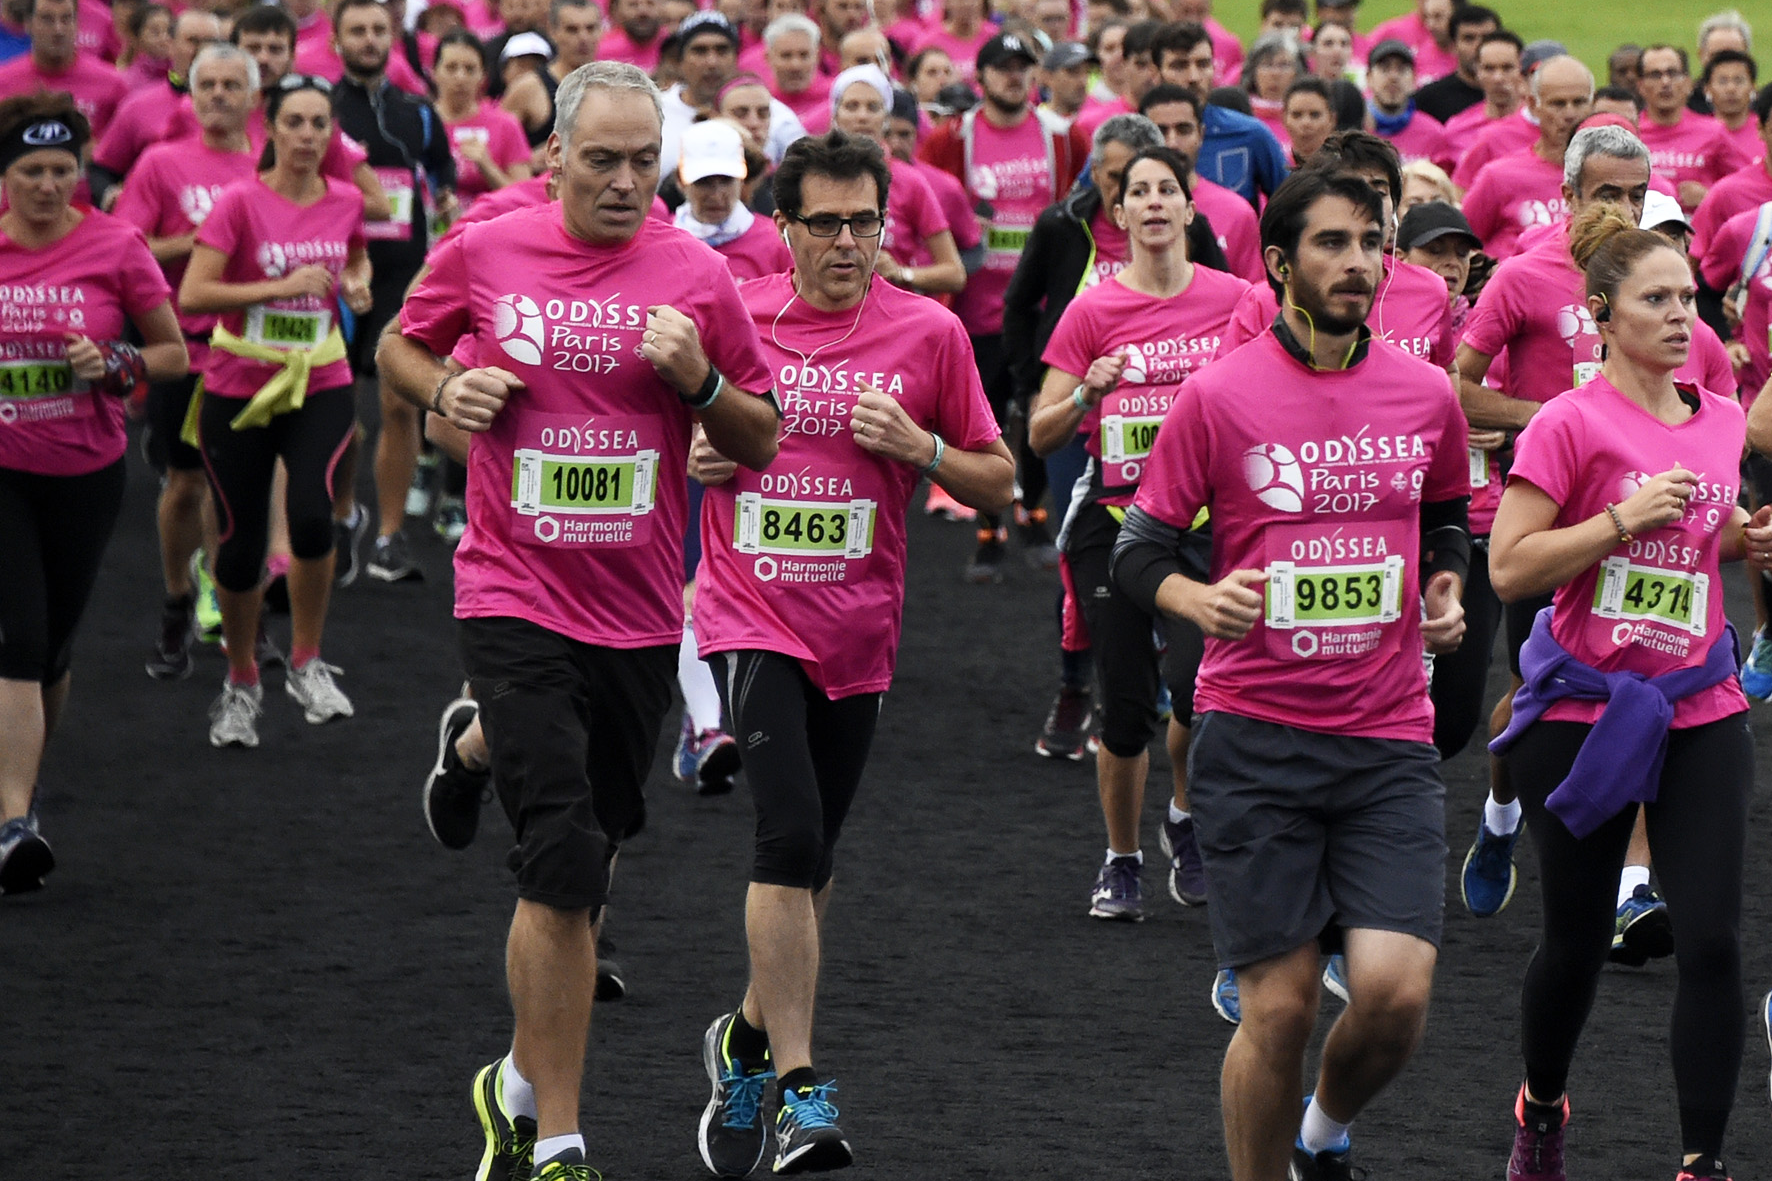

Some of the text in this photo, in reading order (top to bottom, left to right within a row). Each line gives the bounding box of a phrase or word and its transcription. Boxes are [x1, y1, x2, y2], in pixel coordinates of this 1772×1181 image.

[545, 292, 641, 328] ODYSS
[551, 325, 622, 352] Paris
[553, 351, 620, 375] 2017
[1150, 357, 1192, 371] Paris
[784, 390, 848, 416] Paris
[1119, 389, 1173, 415] ODYSS
[784, 414, 844, 437] 2017
[553, 466, 621, 502] 10081
[1310, 469, 1380, 491] Paris
[1313, 492, 1379, 513] 2017
[563, 519, 633, 532] Harmonie
[563, 532, 632, 543] mutuelle
[763, 510, 846, 544] 8463
[1629, 534, 1700, 567] ODYSSE
[781, 560, 846, 572] Harmonie
[781, 571, 845, 582] mutuelle
[1297, 575, 1381, 611] 9853
[1625, 578, 1690, 618] 4314
[1322, 628, 1382, 643] Harmonie
[1632, 633, 1688, 658] mutuelle
[1635, 623, 1690, 648] Harmonie
[1322, 642, 1380, 655] mutuelle
